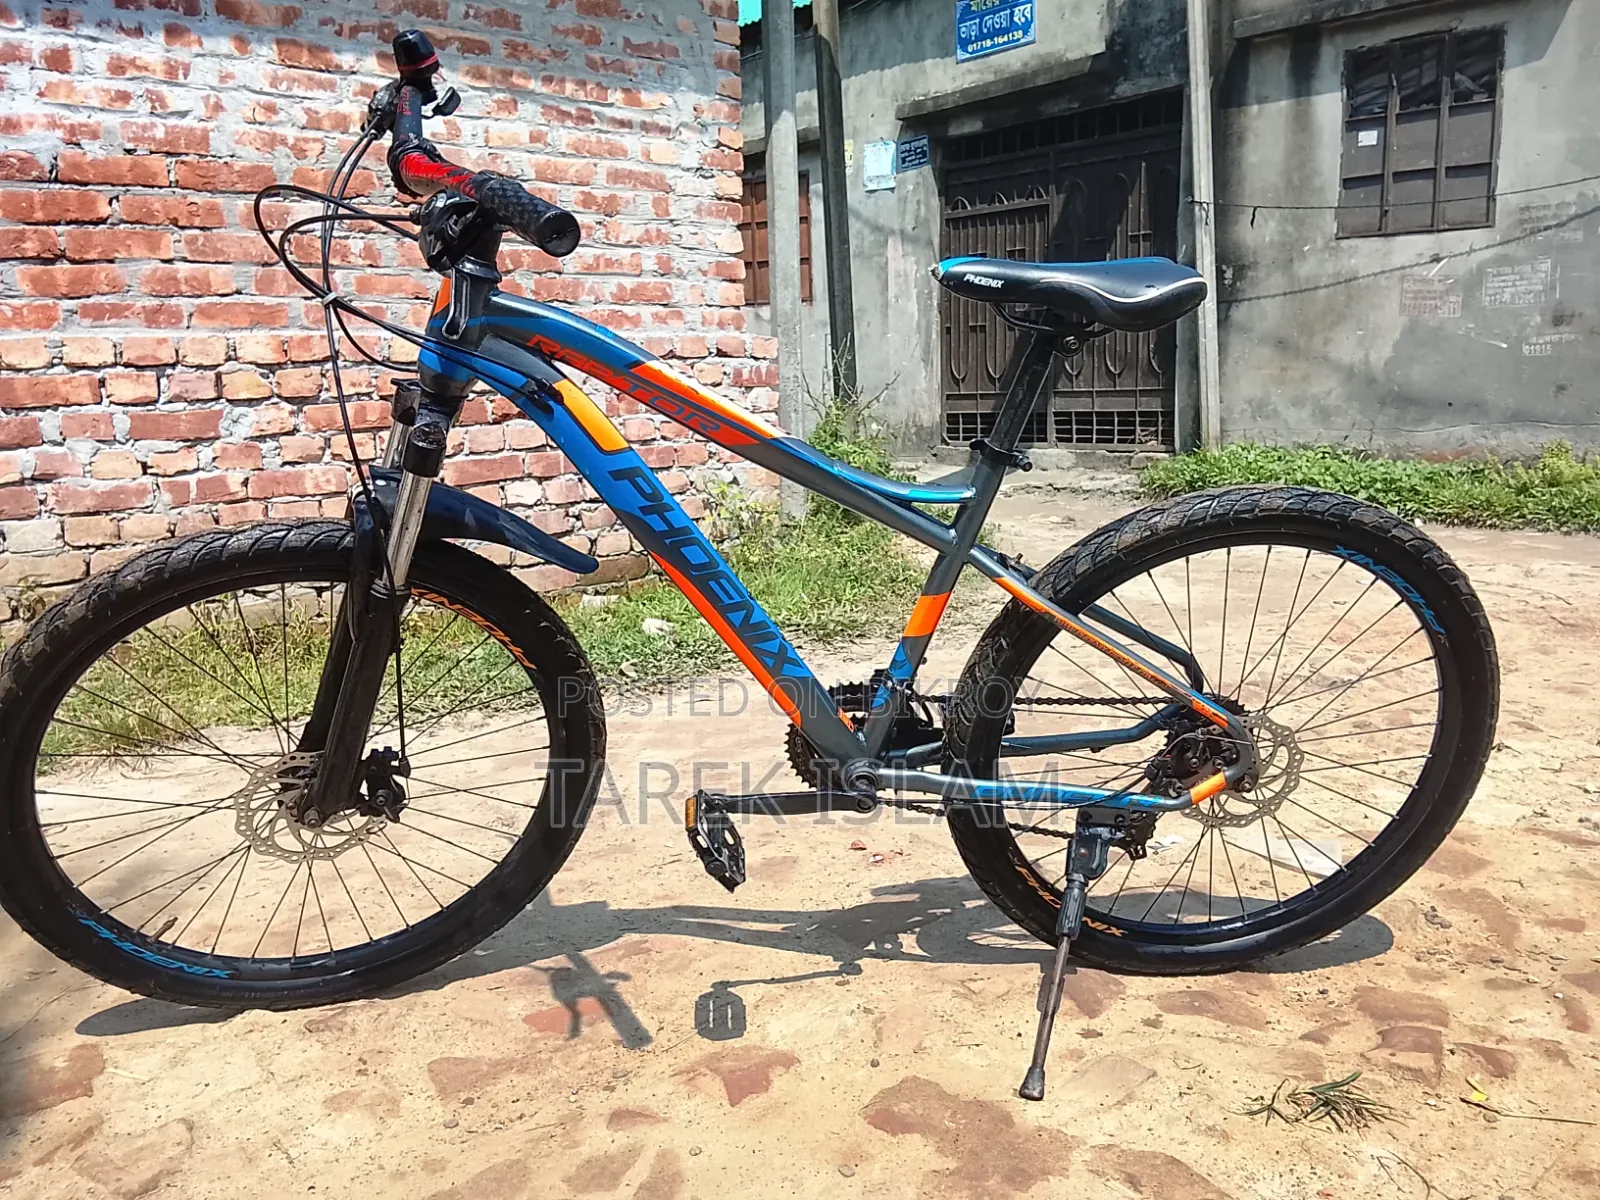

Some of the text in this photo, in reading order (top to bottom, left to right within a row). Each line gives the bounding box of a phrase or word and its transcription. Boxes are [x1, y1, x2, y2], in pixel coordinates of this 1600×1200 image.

[959, 3, 1033, 40] ভাড়া দেওয়া হবে
[964, 274, 1004, 288] PHOENIX
[607, 466, 805, 678] PHOENIX
[1329, 544, 1446, 634] PHOENIX
[1014, 864, 1128, 937] PHONIX
[72, 907, 235, 979] PHOENIX
